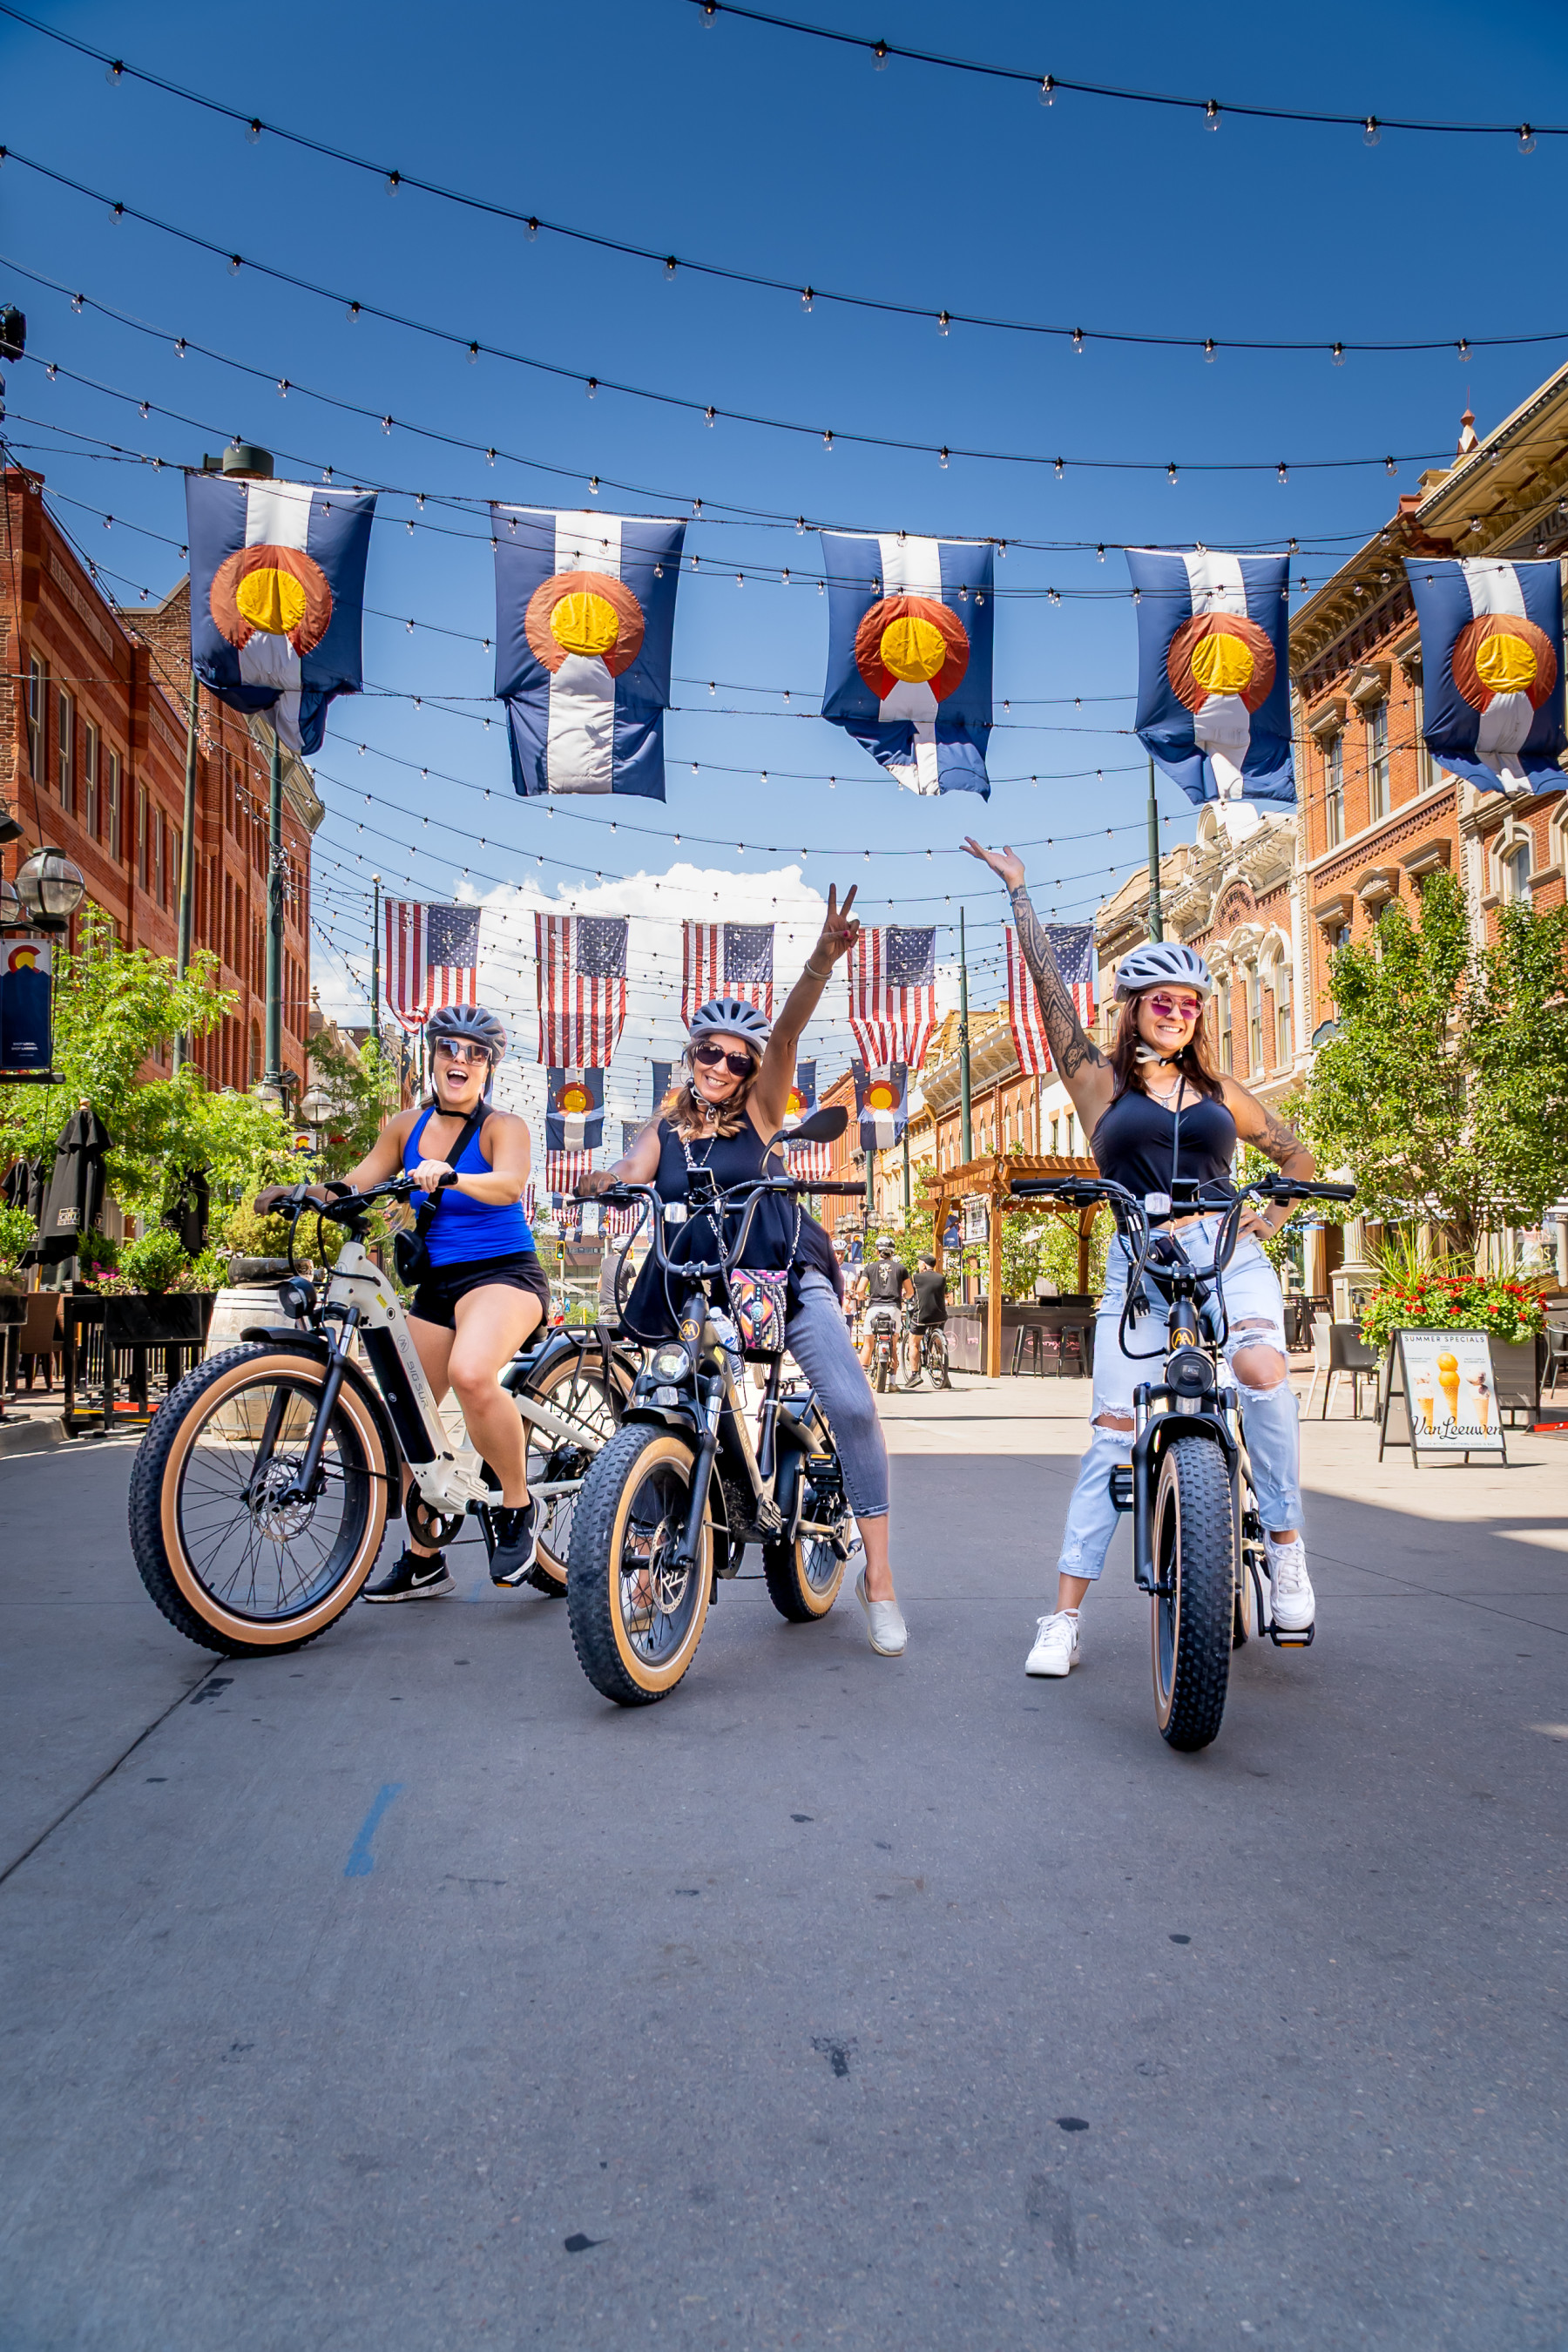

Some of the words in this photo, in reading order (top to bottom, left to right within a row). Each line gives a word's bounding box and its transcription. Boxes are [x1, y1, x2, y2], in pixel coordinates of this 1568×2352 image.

[407, 1361, 420, 1382] BIG
[415, 1382, 429, 1410] SUR
[1411, 1416, 1441, 1436] Van
[1439, 1416, 1503, 1440] Leeuwen
